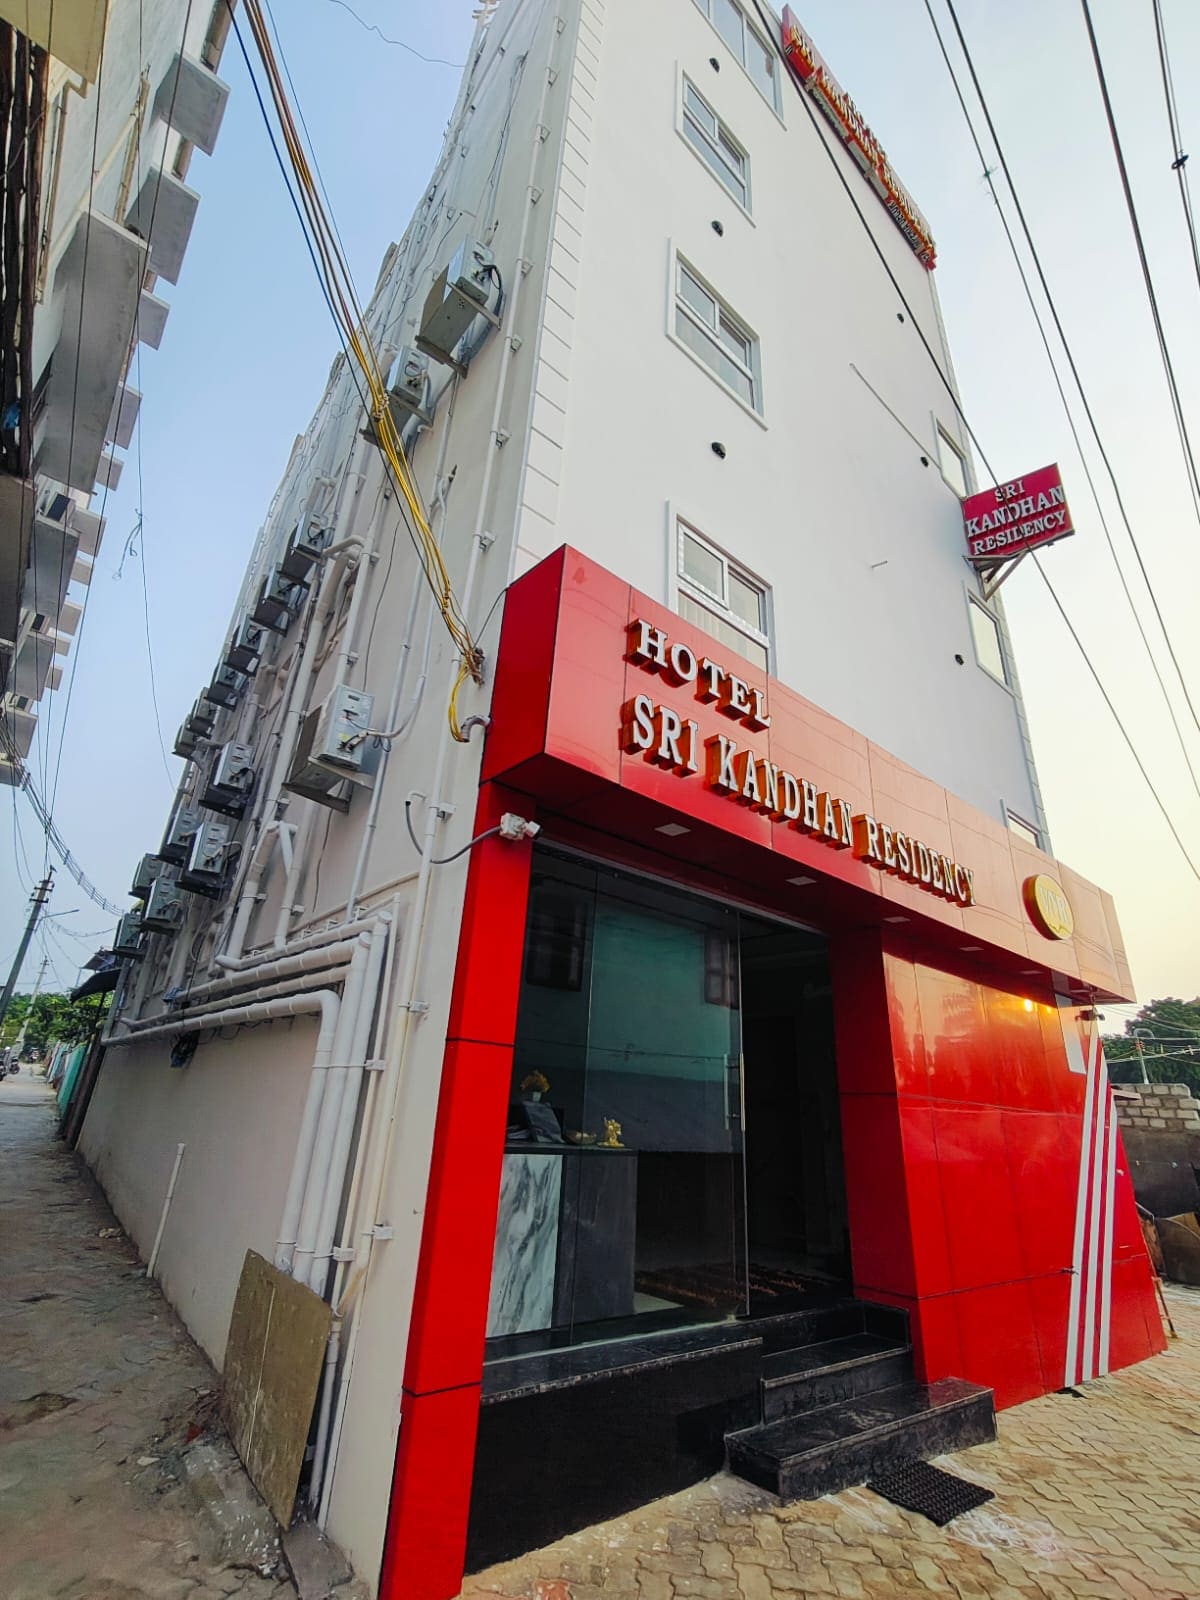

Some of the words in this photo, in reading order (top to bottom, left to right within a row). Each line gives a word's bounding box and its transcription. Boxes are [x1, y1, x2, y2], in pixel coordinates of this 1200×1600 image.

[965, 485, 1065, 538] KANDHAN
[994, 479, 1025, 502] SRI
[632, 619, 772, 730] HOTEL
[629, 694, 699, 775] SRI
[714, 734, 853, 849] KANDHAN
[859, 813, 977, 907] RESIDENCY
